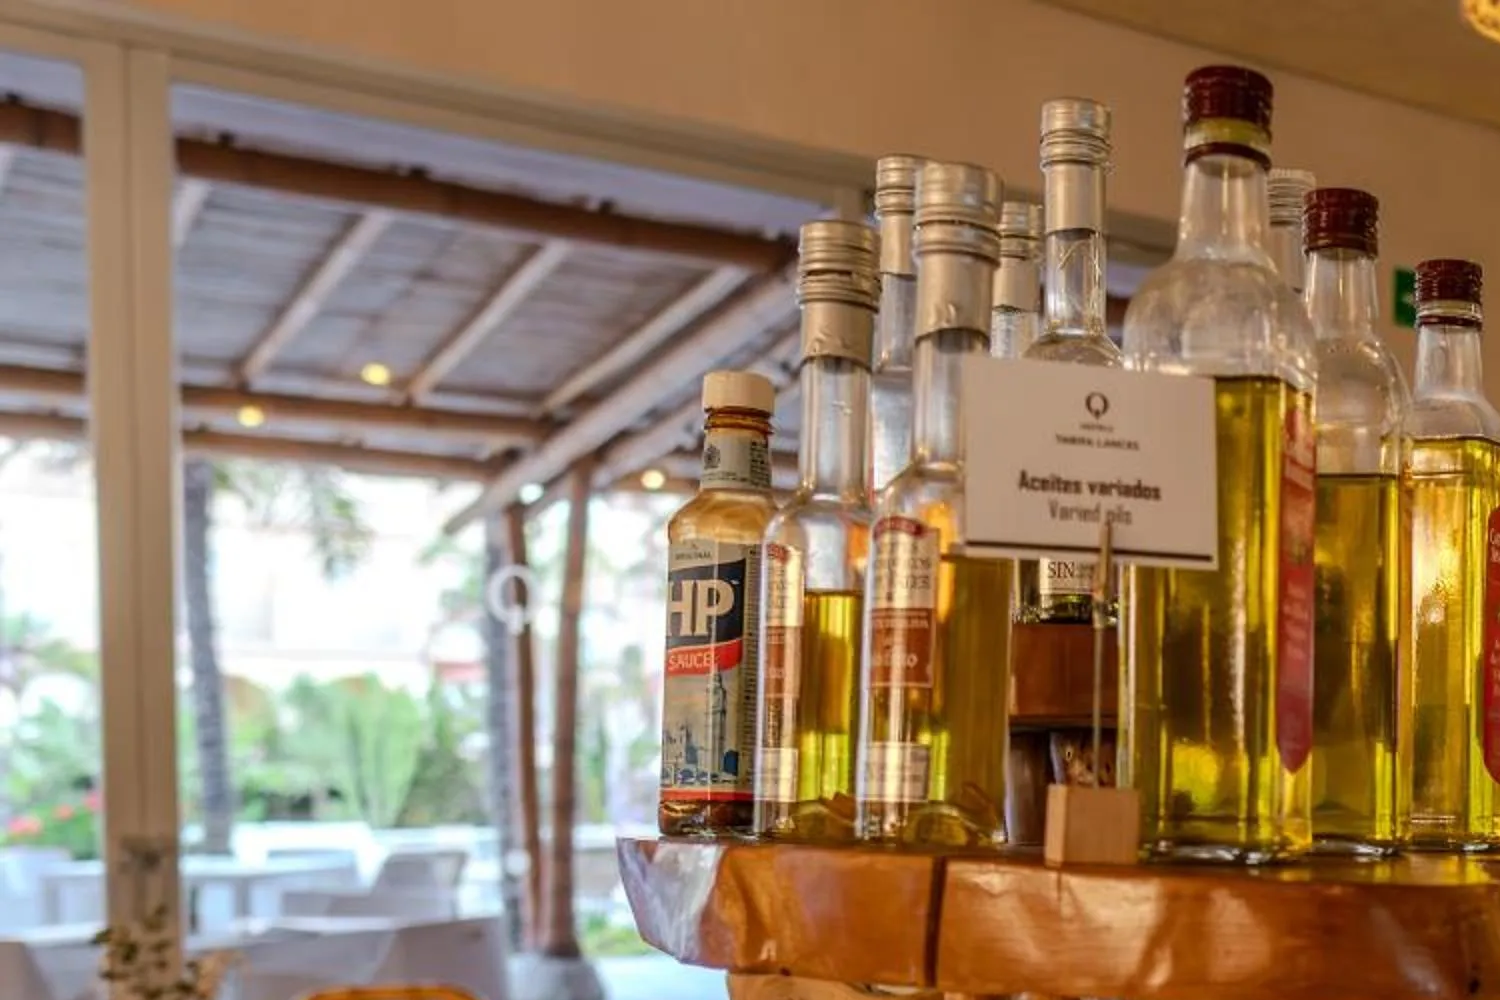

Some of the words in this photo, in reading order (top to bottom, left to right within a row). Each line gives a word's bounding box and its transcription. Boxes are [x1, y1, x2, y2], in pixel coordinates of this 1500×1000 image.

[1018, 470, 1083, 495] Aceites
[1088, 479, 1162, 501] variados
[1048, 500, 1101, 523] Varied
[667, 579, 735, 637] HP
[667, 650, 714, 671] SAUCE
